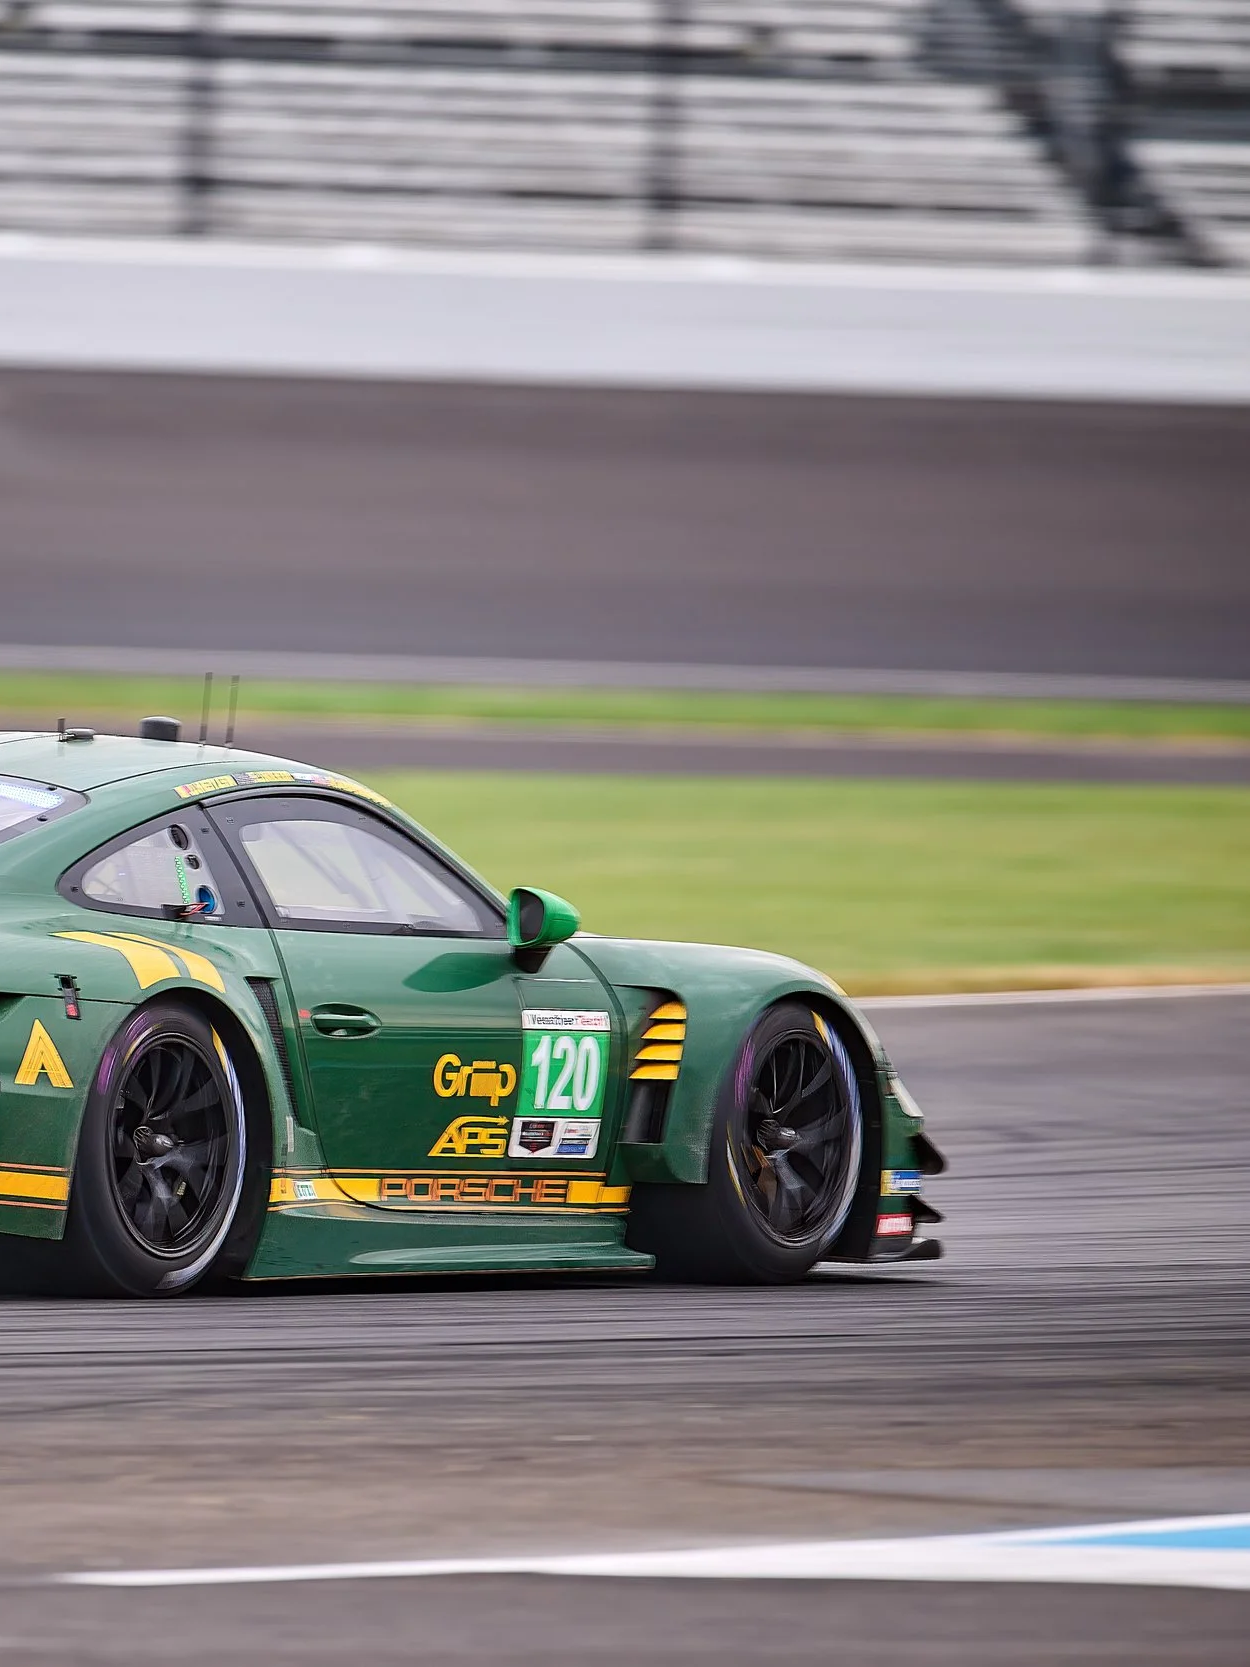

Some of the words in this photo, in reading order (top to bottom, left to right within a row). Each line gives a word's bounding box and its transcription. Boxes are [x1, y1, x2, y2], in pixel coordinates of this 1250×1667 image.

[531, 1035, 601, 1111] 120
[427, 1115, 509, 1158] APS
[380, 1178, 568, 1203] PORSCHE
